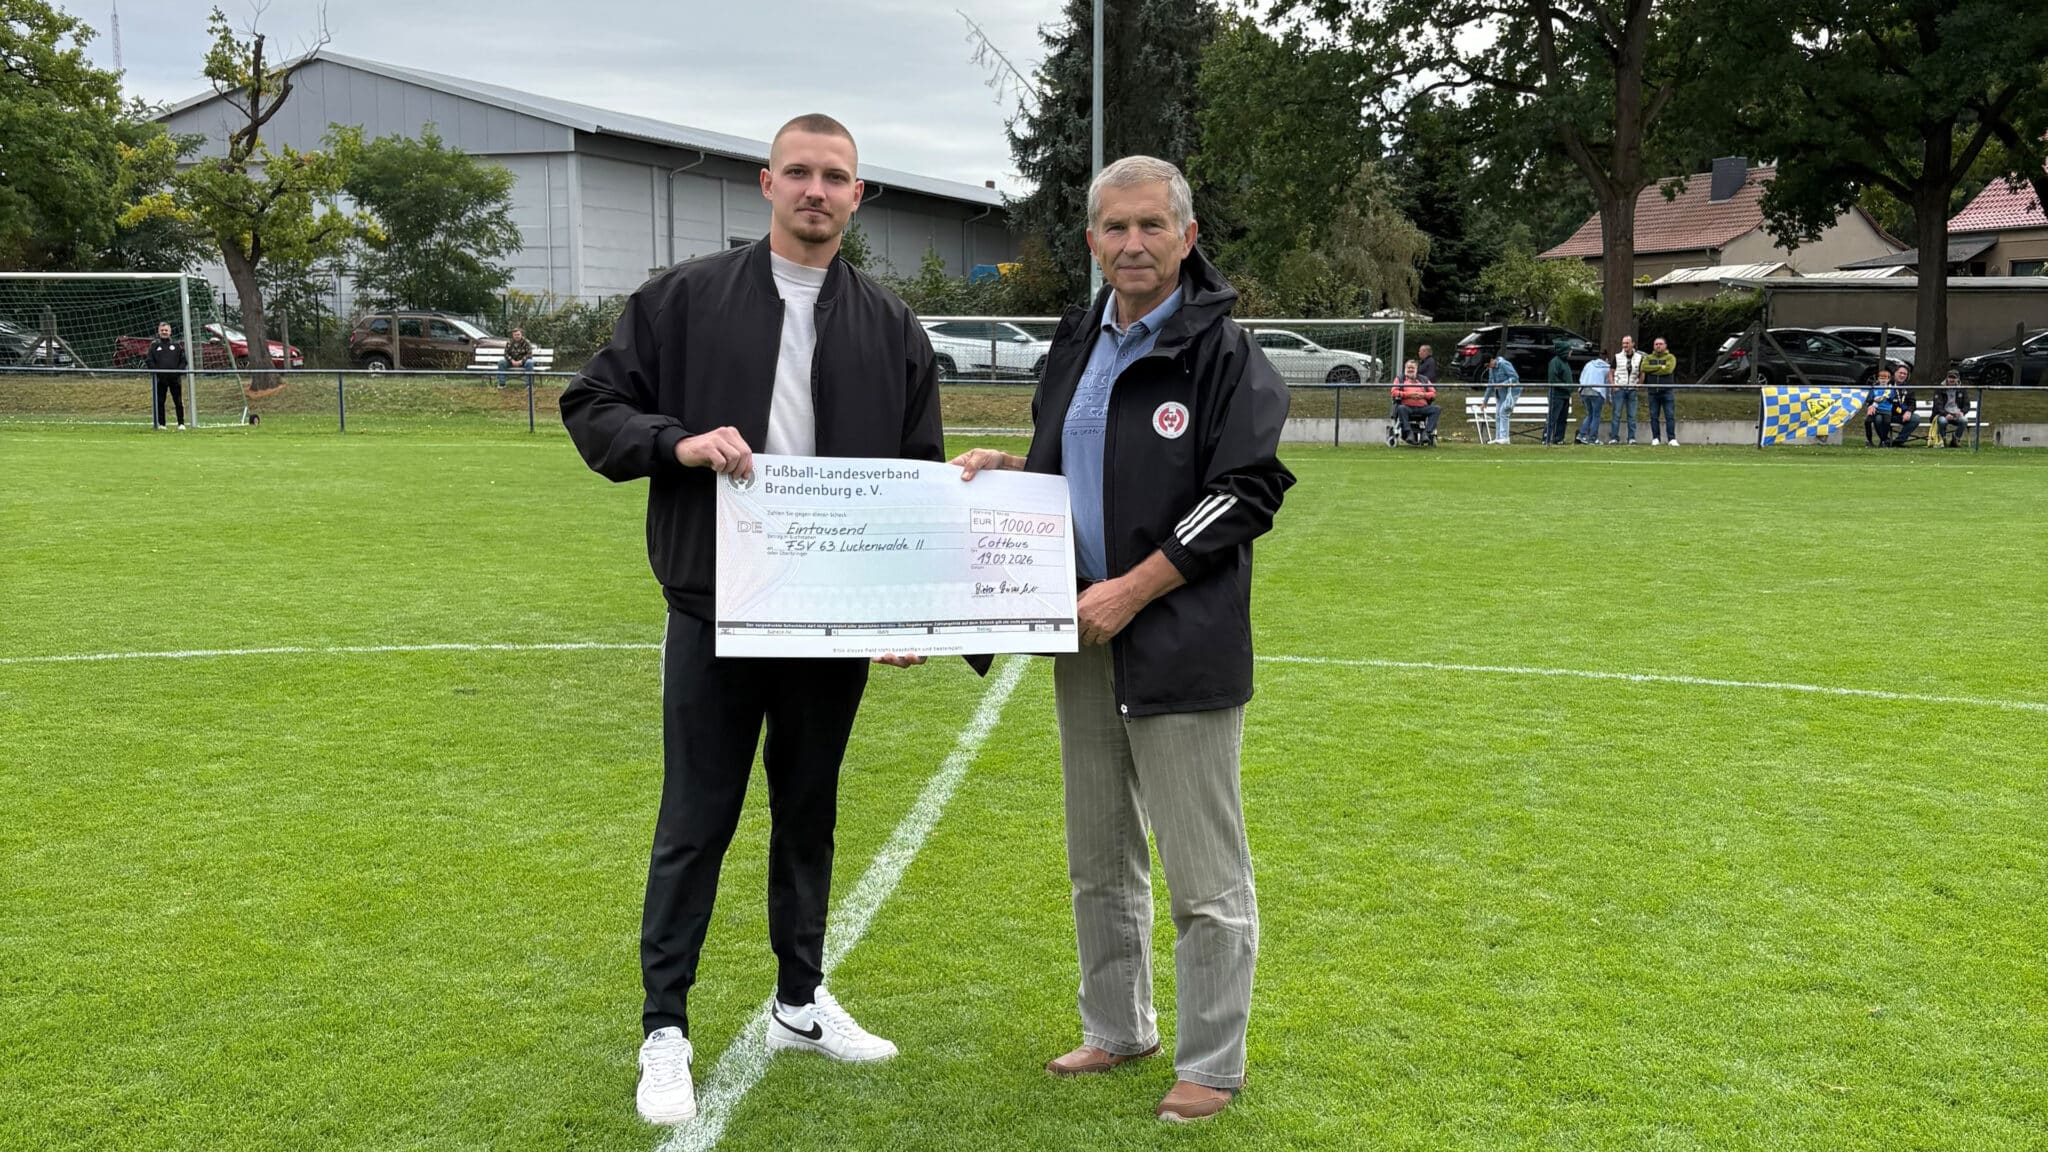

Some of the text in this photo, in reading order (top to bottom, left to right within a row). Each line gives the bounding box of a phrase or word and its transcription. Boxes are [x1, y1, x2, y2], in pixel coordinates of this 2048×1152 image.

[765, 464, 920, 480] Fußball-Landesverband
[765, 482, 852, 498] Brandenburg
[855, 486, 867, 496] e.
[870, 484, 883, 496] V.
[737, 520, 763, 533] DE
[973, 517, 992, 525] EUR
[999, 518, 1056, 534] 1000,00
[786, 522, 868, 536] Eintausend
[785, 540, 816, 551] FSV
[819, 540, 836, 552] 63
[840, 538, 909, 552] Luckenwalde
[978, 536, 1030, 548] Cottbus
